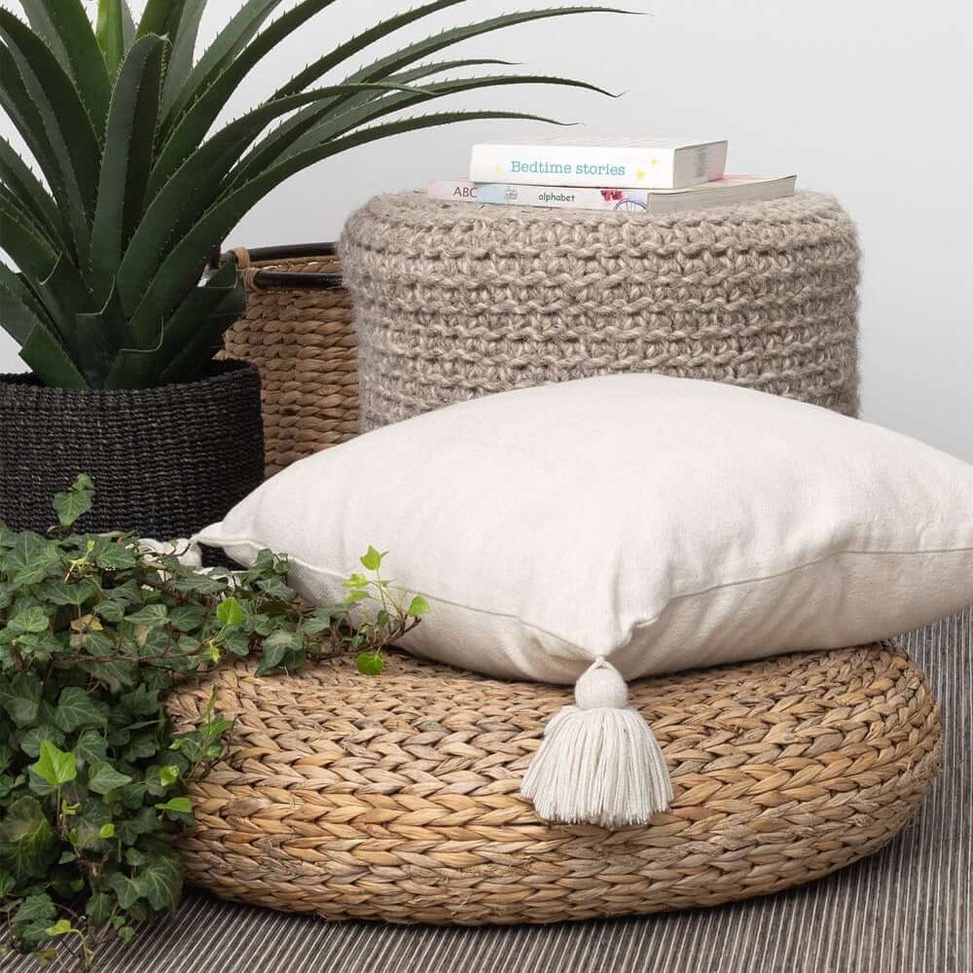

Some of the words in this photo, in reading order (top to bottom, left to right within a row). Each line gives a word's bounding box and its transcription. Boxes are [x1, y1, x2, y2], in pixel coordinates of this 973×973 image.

[511, 160, 572, 174] Bedtime
[575, 163, 626, 176] stories
[453, 186, 478, 199] ABC
[538, 192, 576, 203] alphabet
